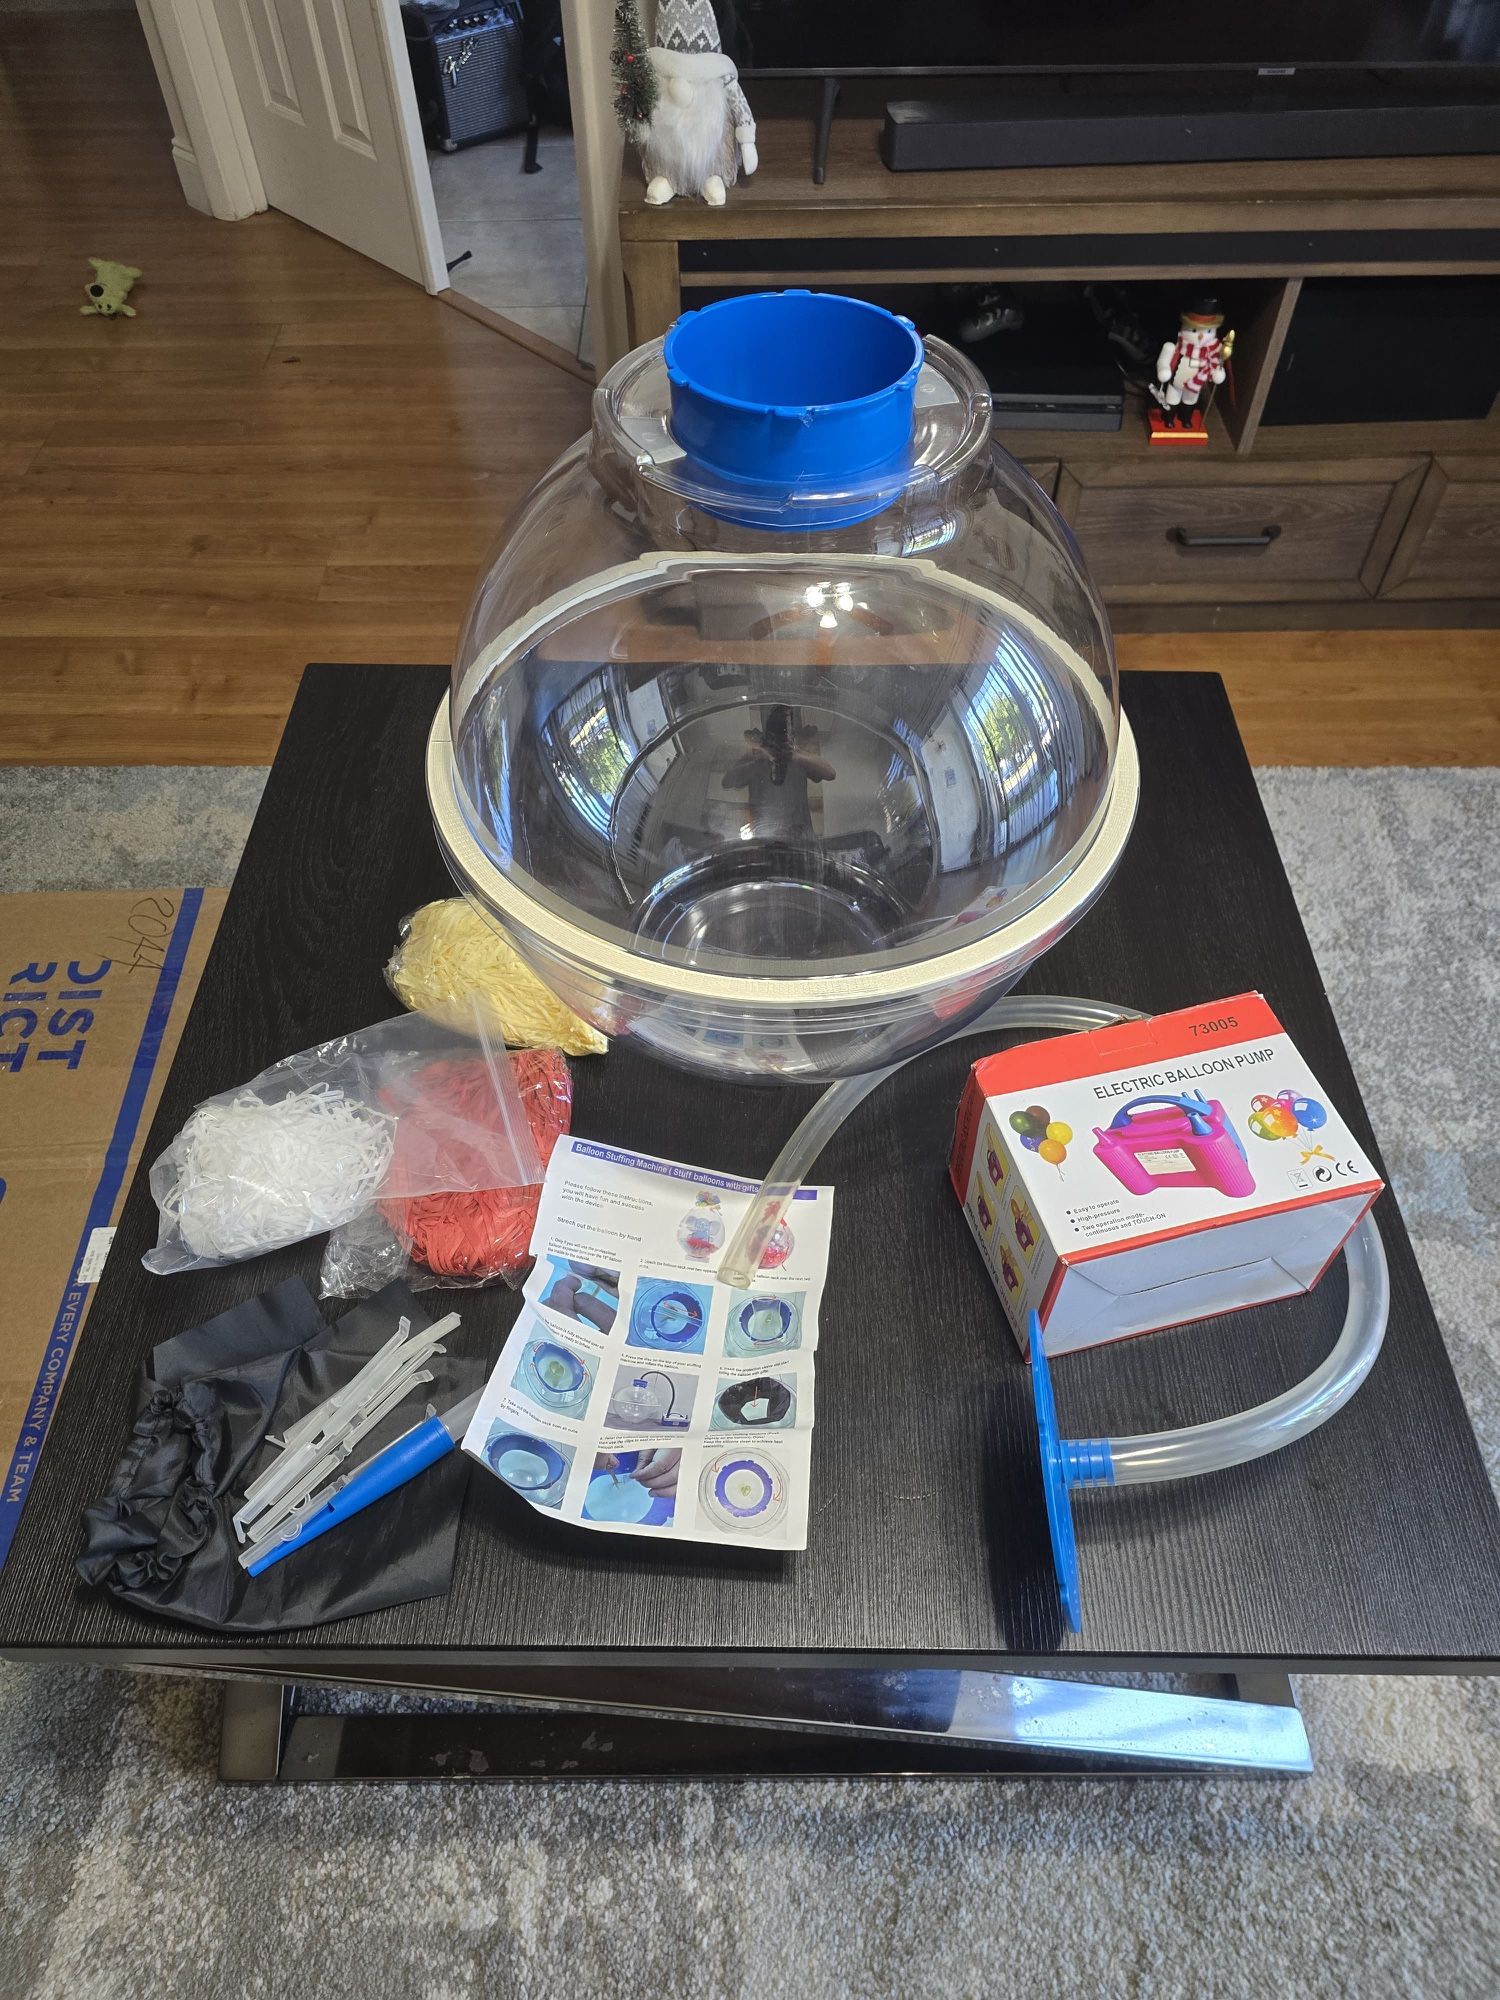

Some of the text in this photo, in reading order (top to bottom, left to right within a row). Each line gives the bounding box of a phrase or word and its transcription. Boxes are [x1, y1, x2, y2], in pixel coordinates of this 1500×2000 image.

[95, 897, 174, 974] 2044
[37, 959, 112, 1070] DIST
[1188, 1016, 1239, 1037] 73005
[1093, 1048, 1275, 1099] ELECTRIC BALLOON PUMP
[576, 1143, 605, 1159] Balloon
[605, 1152, 636, 1167] Stuffing
[636, 1159, 668, 1174] Machine
[673, 1168, 692, 1180] Stuff
[693, 1173, 725, 1187] balloons
[725, 1179, 741, 1189] with
[741, 1182, 760, 1193] gifts
[562, 1187, 573, 1195] you
[574, 1189, 584, 1197] will
[610, 1198, 621, 1206] and
[564, 1180, 584, 1190] Please
[584, 1184, 601, 1193] follow
[602, 1189, 618, 1198] these
[575, 1196, 584, 1204] the
[1073, 1206, 1089, 1214] Easy
[1096, 1199, 1120, 1209] operate
[1077, 1208, 1120, 1222] High-pressure
[1085, 1226, 1120, 1237] continuous
[1132, 1213, 1167, 1225] TOUCH-ON
[1095, 1218, 1125, 1229] operation
[587, 1224, 596, 1232] the
[619, 1230, 626, 1239] by
[627, 1233, 642, 1242] hand
[56, 1292, 82, 1343] EVERY
[29, 1347, 64, 1431] COMPANY
[24, 1435, 38, 1447] &
[6, 1451, 34, 1503] TEAM
